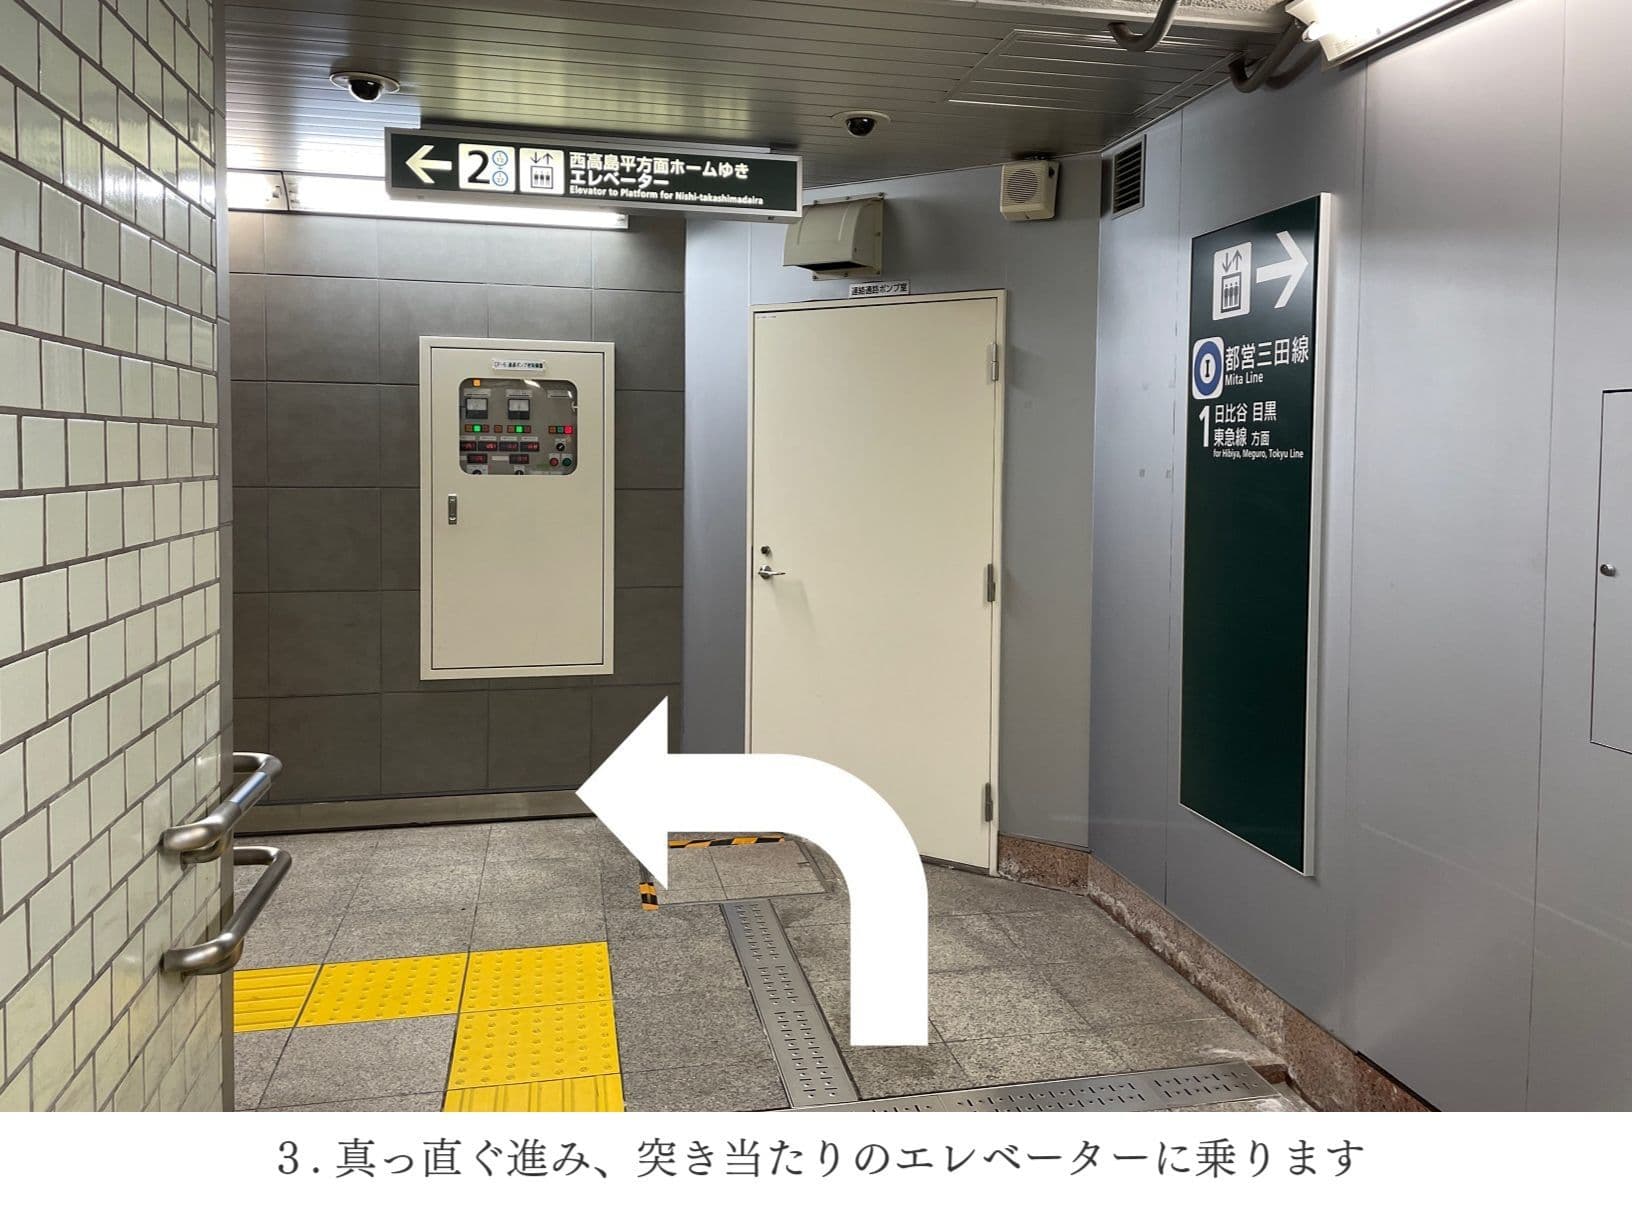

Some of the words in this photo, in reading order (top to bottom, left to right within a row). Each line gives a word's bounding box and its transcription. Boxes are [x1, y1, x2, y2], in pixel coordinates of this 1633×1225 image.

[467, 150, 490, 184] 2
[569, 152, 749, 179] 西高島平方面ホームゆき
[570, 169, 669, 189] エレベーター
[569, 185, 607, 196] Elevator
[608, 187, 619, 197] to
[620, 188, 658, 199] Platform
[660, 190, 673, 200] for
[675, 191, 763, 205] Nishi-takashimadaira
[1225, 335, 1309, 372] 都営三田線
[1225, 373, 1243, 386] Mita
[1246, 371, 1264, 384] Line
[1215, 403, 1248, 424] 日比谷
[1253, 401, 1277, 422] 目黒
[1199, 405, 1210, 447] 1
[1213, 427, 1248, 447] 東急線
[1251, 430, 1270, 447] 方面
[1213, 448, 1221, 458] for
[1222, 448, 1241, 460] Hibiya,
[1242, 448, 1267, 460] Meguro,
[1268, 448, 1289, 460] Tokyu
[1289, 447, 1304, 458] Line
